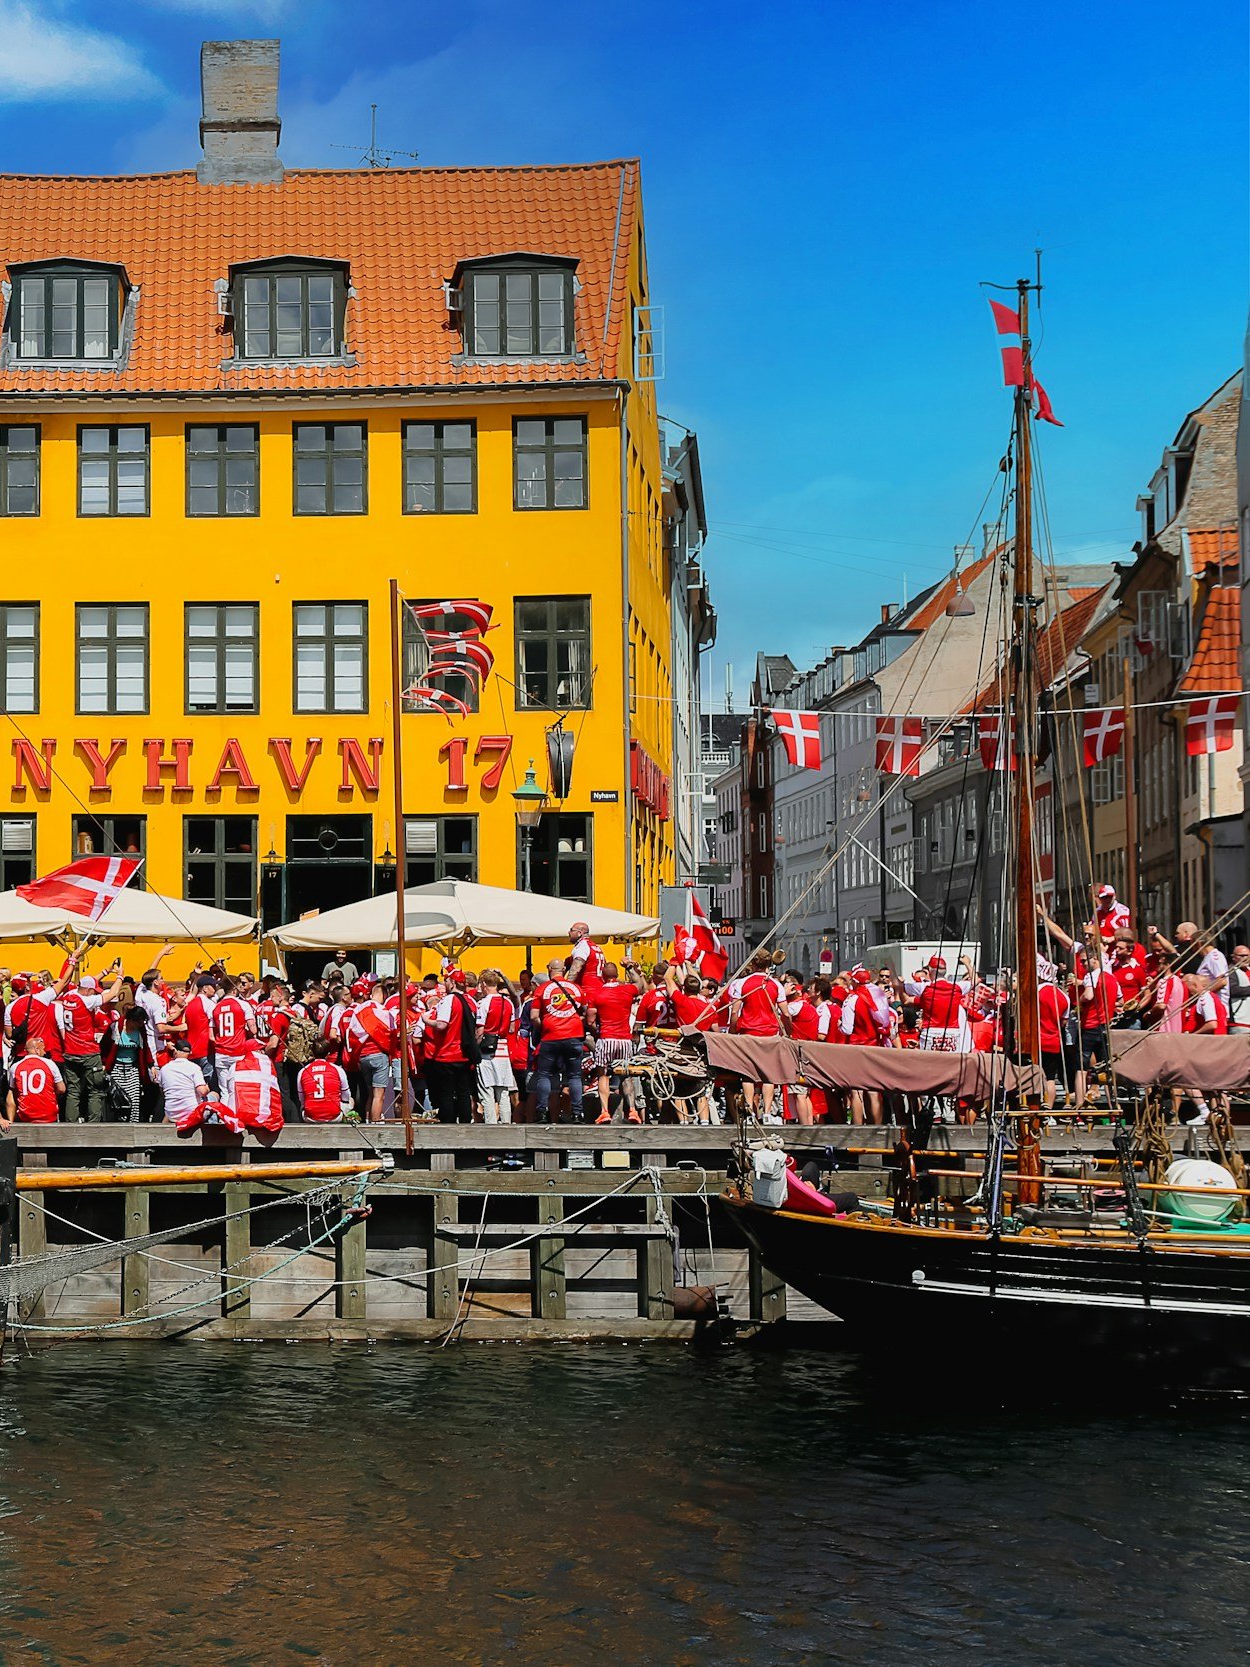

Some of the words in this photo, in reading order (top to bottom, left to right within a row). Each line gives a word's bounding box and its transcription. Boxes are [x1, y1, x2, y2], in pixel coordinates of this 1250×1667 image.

[11, 737, 385, 791] NYHAVN
[438, 735, 513, 789] 17
[593, 792, 617, 801] Nyhavn
[218, 1011, 235, 1038] 19
[19, 1068, 47, 1097] 10
[313, 1073, 325, 1099] 3
